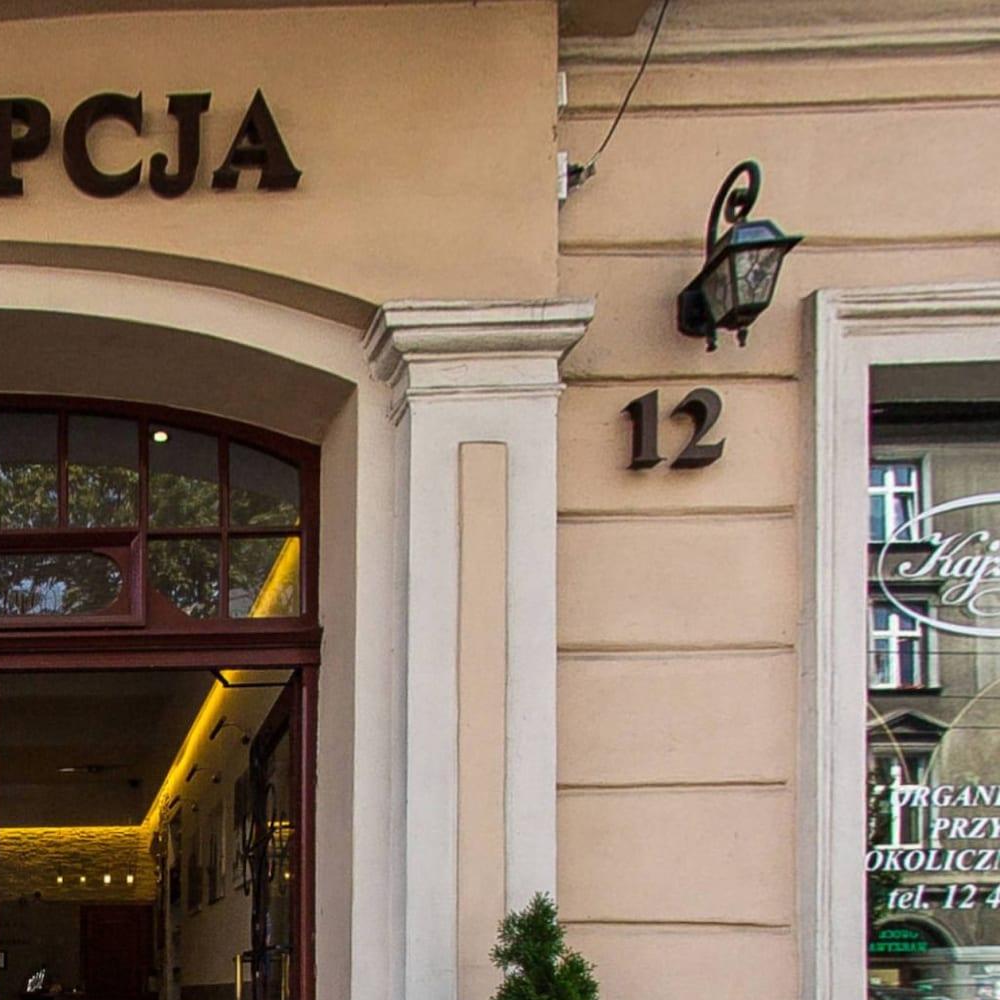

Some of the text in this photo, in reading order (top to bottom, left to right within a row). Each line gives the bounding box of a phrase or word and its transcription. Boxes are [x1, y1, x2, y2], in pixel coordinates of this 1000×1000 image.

[620, 387, 726, 470] 12
[889, 885, 929, 909] tel.
[942, 884, 978, 909] 12
